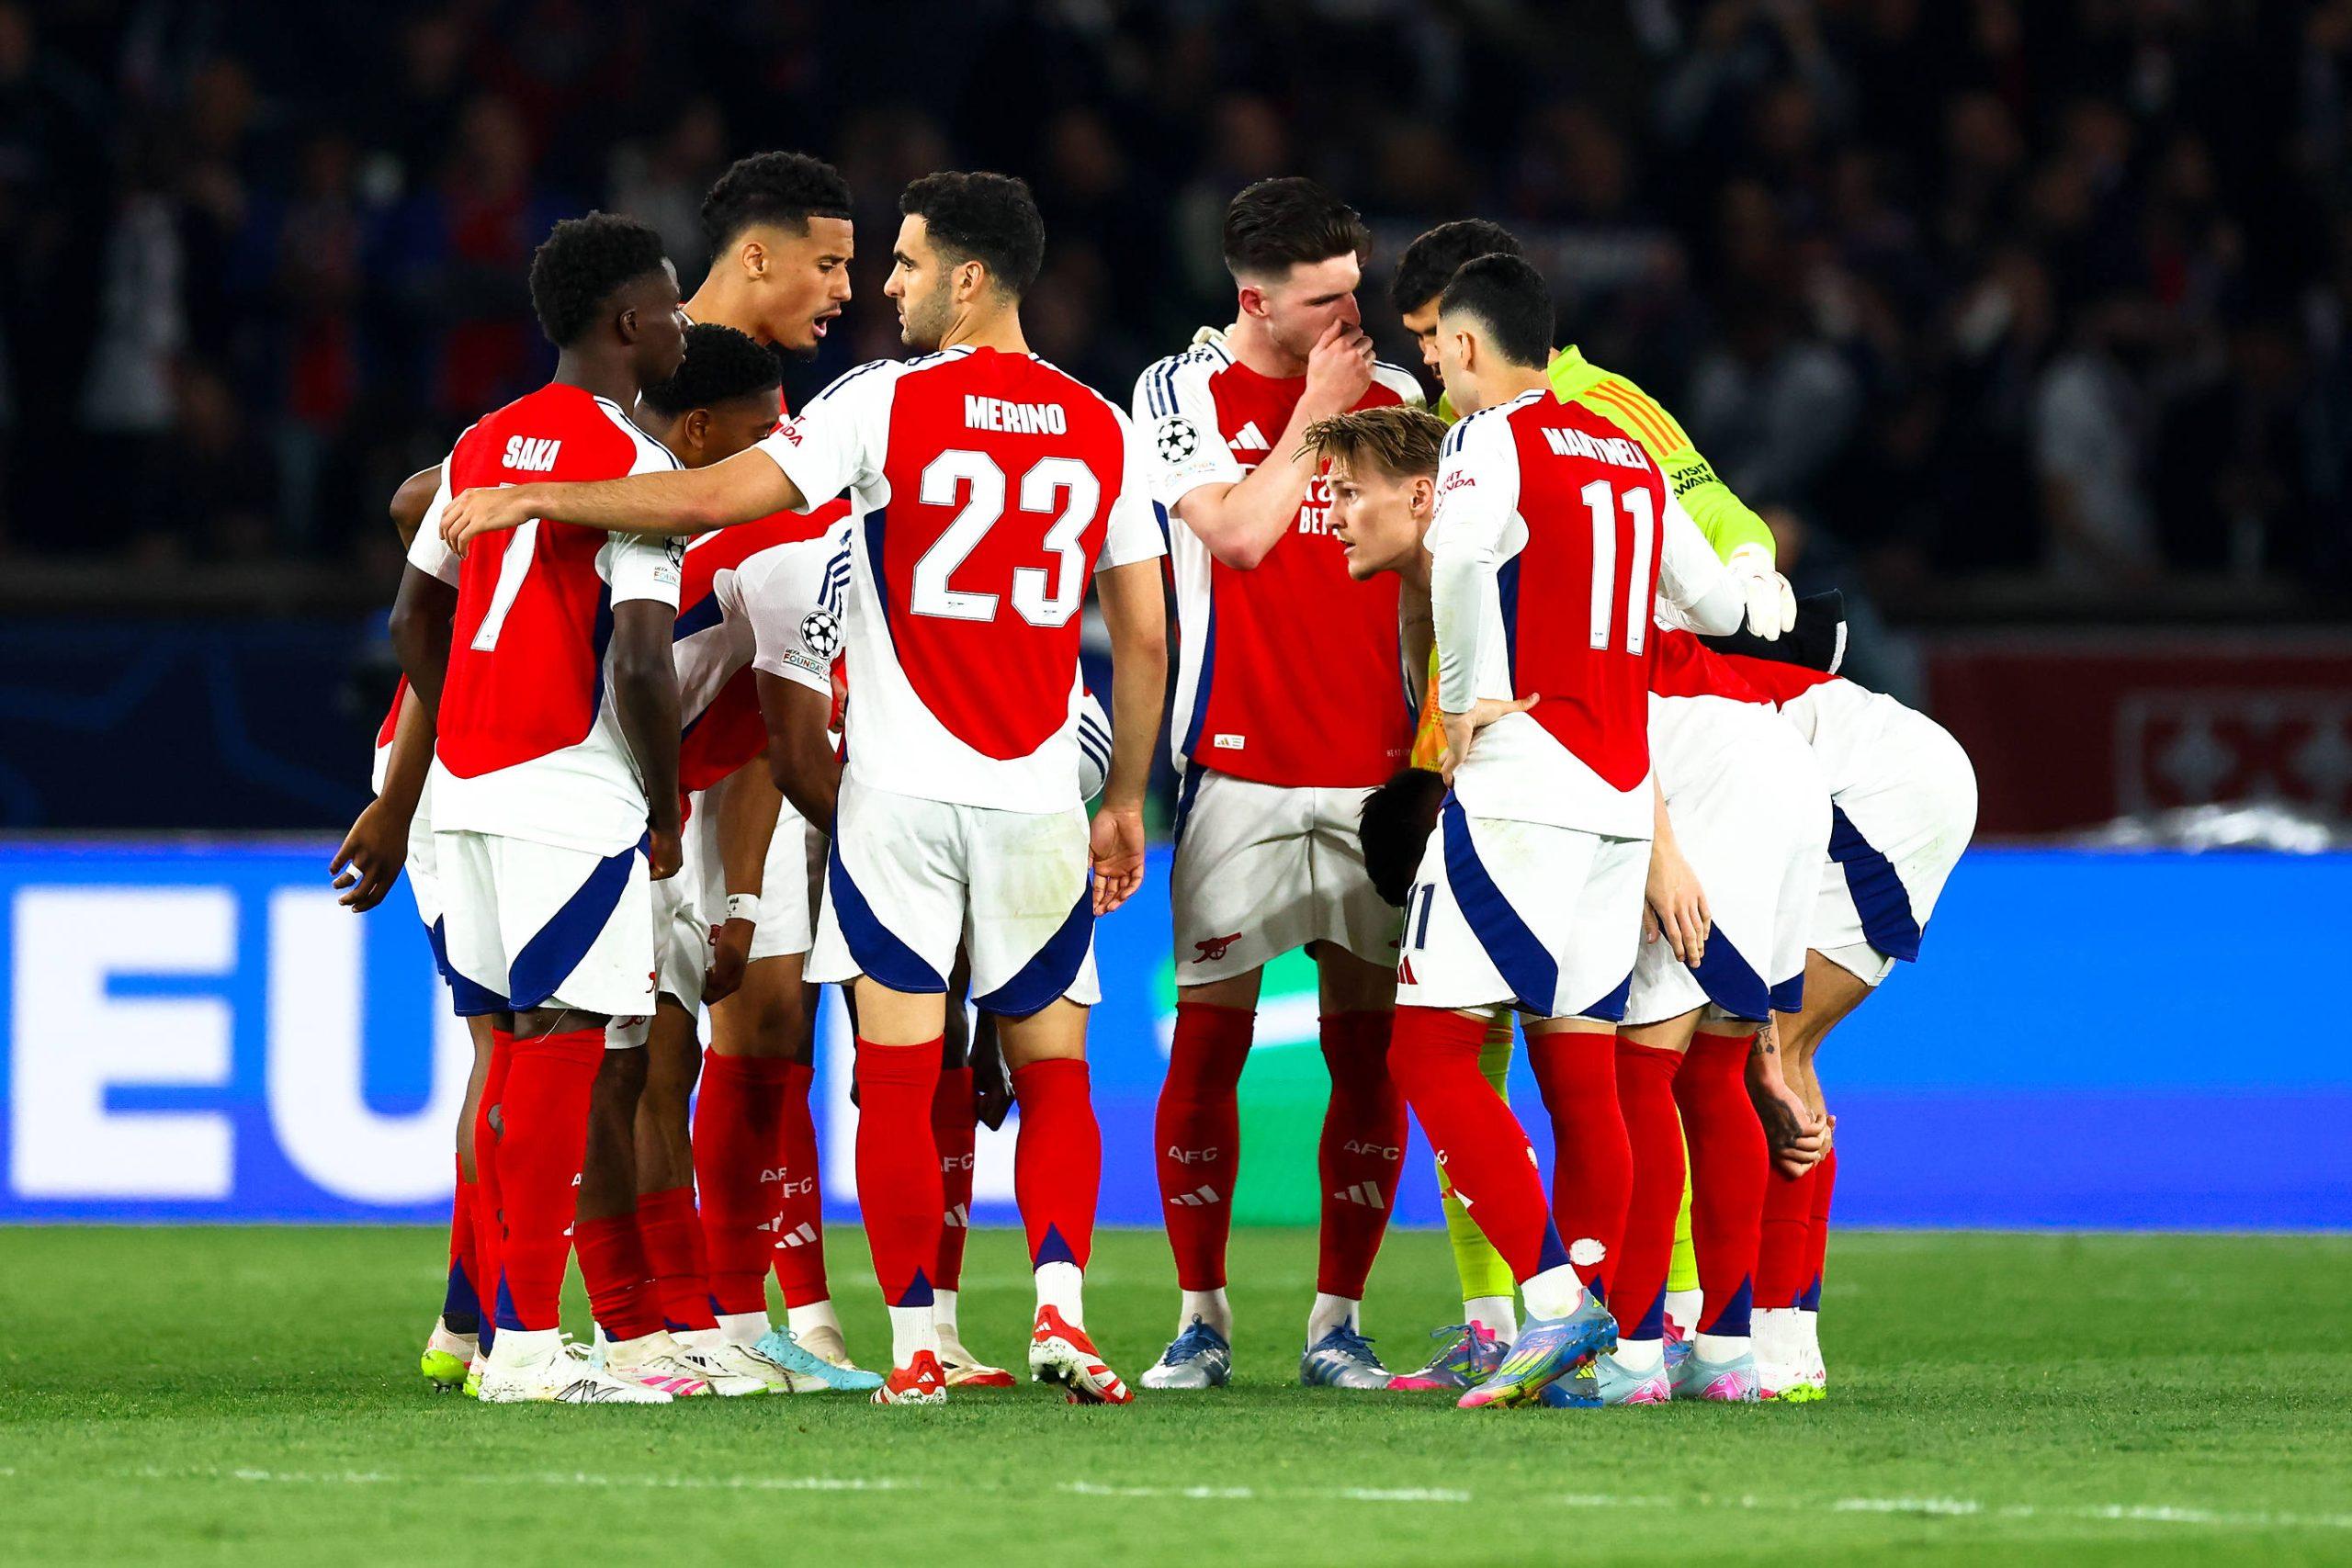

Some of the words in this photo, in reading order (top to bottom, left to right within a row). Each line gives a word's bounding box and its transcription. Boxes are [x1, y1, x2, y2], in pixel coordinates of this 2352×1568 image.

[964, 395, 1068, 435] MERINO
[502, 435, 561, 472] SAKA
[1670, 462, 1708, 480] VISIT
[1673, 473, 1724, 500] WAN
[1298, 505, 1340, 536] BET
[910, 448, 1101, 627] 23
[470, 481, 541, 652] 7
[1580, 479, 1651, 656] 11
[1401, 882, 1436, 950] 11
[940, 1152, 974, 1173] FC
[1168, 1145, 1217, 1164] AFC
[1343, 1139, 1399, 1160] AFC
[760, 1167, 786, 1183] AF
[783, 1176, 813, 1199] FC
